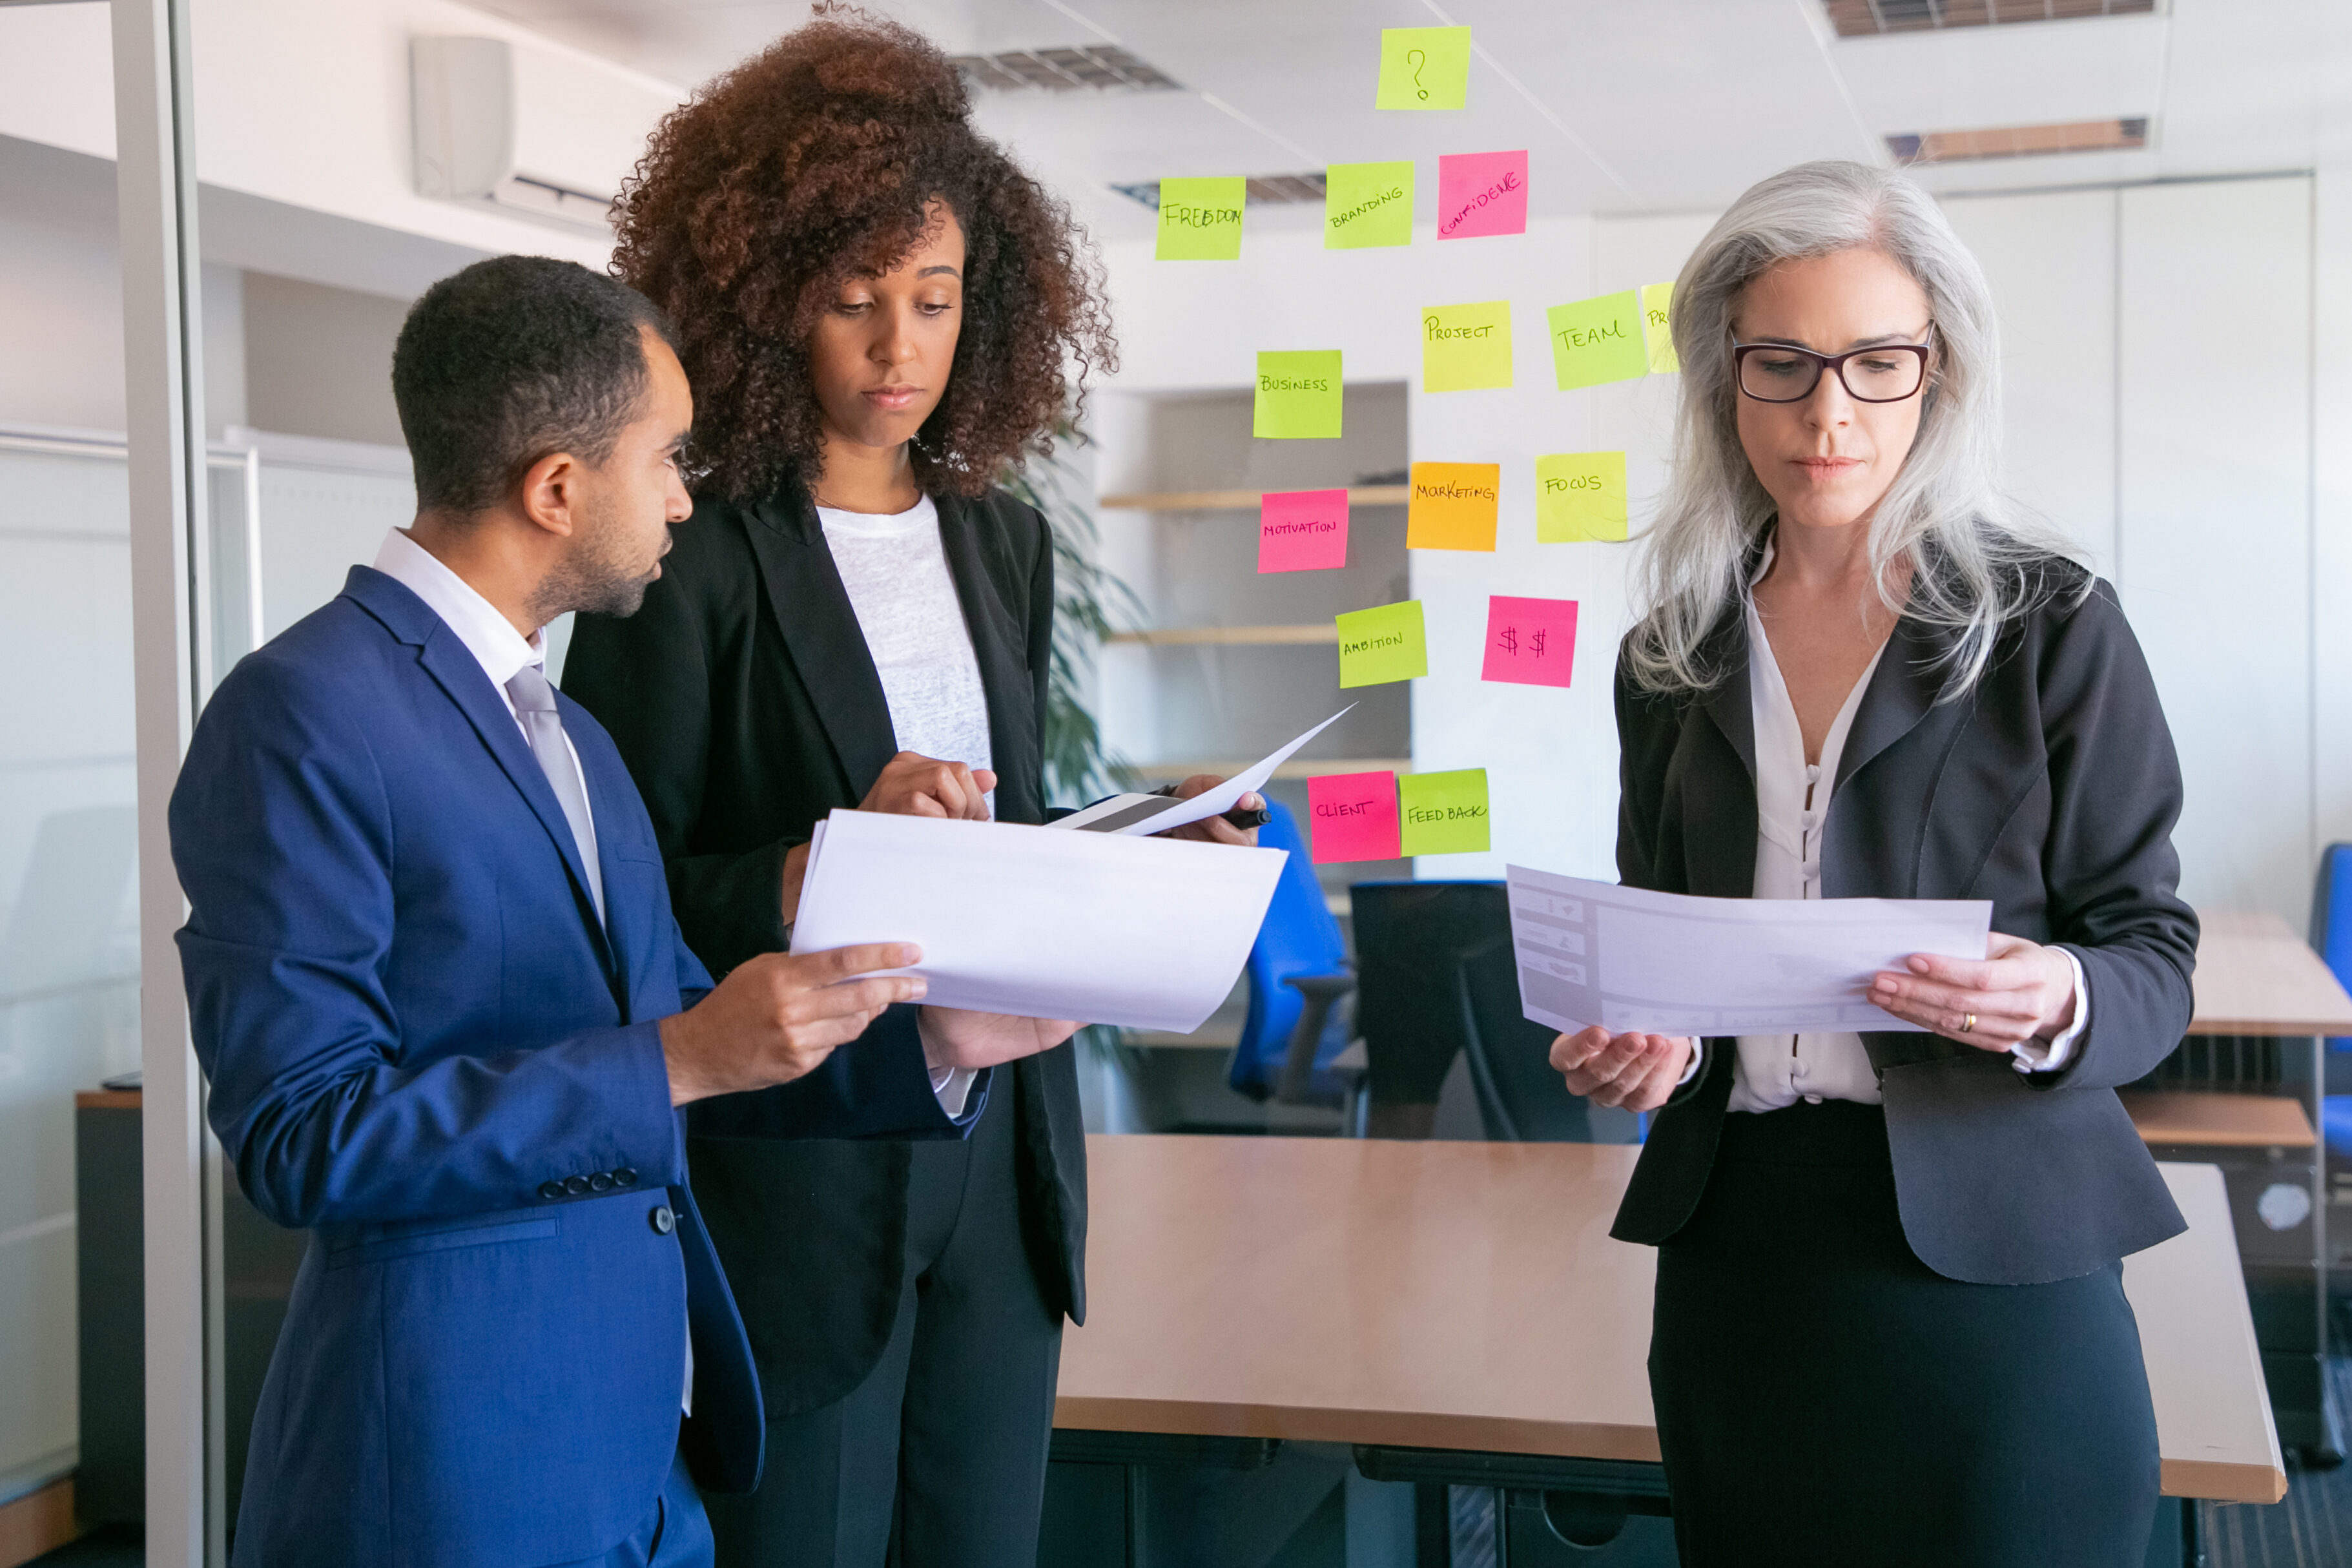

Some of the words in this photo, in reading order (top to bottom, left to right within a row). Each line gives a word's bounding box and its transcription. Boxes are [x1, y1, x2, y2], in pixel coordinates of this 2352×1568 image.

[1407, 50, 1429, 101] ?
[1424, 315, 1494, 341] PROJECT
[1647, 309, 1670, 327] PR
[1557, 320, 1627, 351] TEAM
[1260, 375, 1328, 392] BUSINESS
[1544, 475, 1602, 495] FOCUS
[1316, 800, 1374, 818] CLIENT
